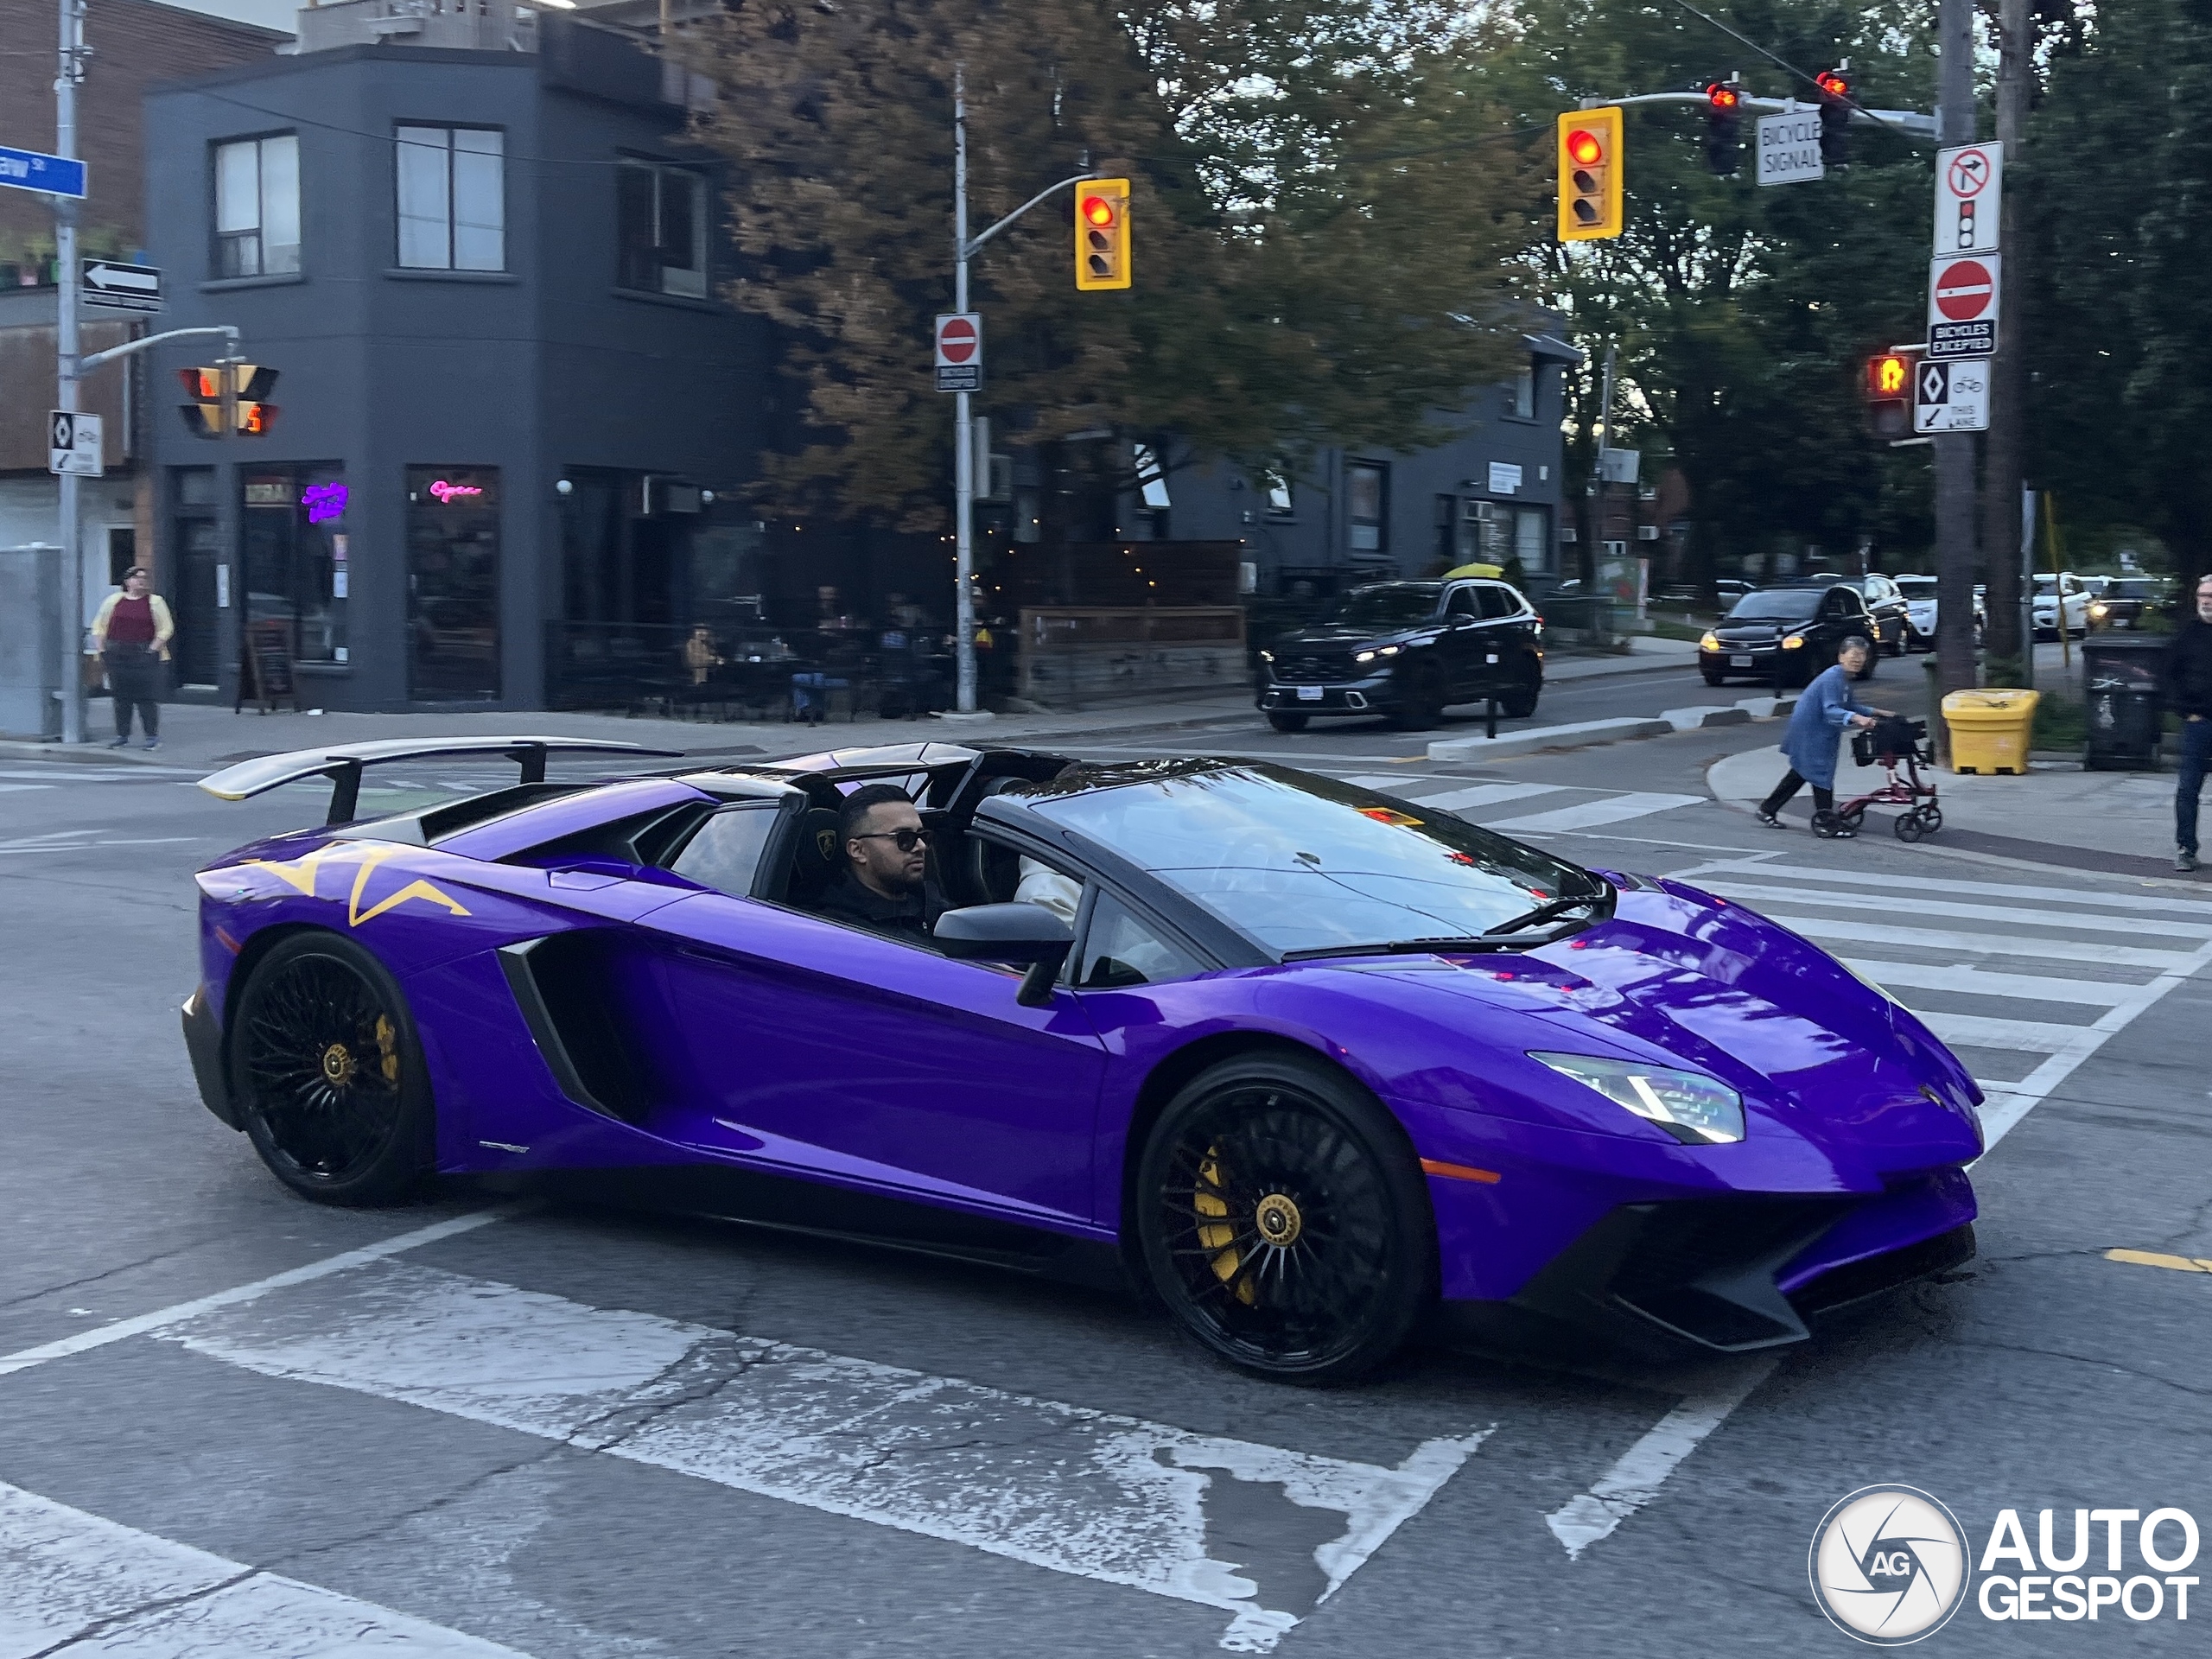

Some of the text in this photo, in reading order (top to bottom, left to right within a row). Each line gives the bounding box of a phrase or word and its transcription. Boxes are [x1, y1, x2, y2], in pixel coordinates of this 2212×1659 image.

[1762, 121, 1821, 146] BICYCLE
[1764, 149, 1818, 172] SIGNAL
[1936, 323, 1990, 339] BICYCLES
[1932, 337, 1993, 353] EXCEPTED
[1951, 405, 1976, 415] THIS
[1948, 416, 1977, 428] LANE
